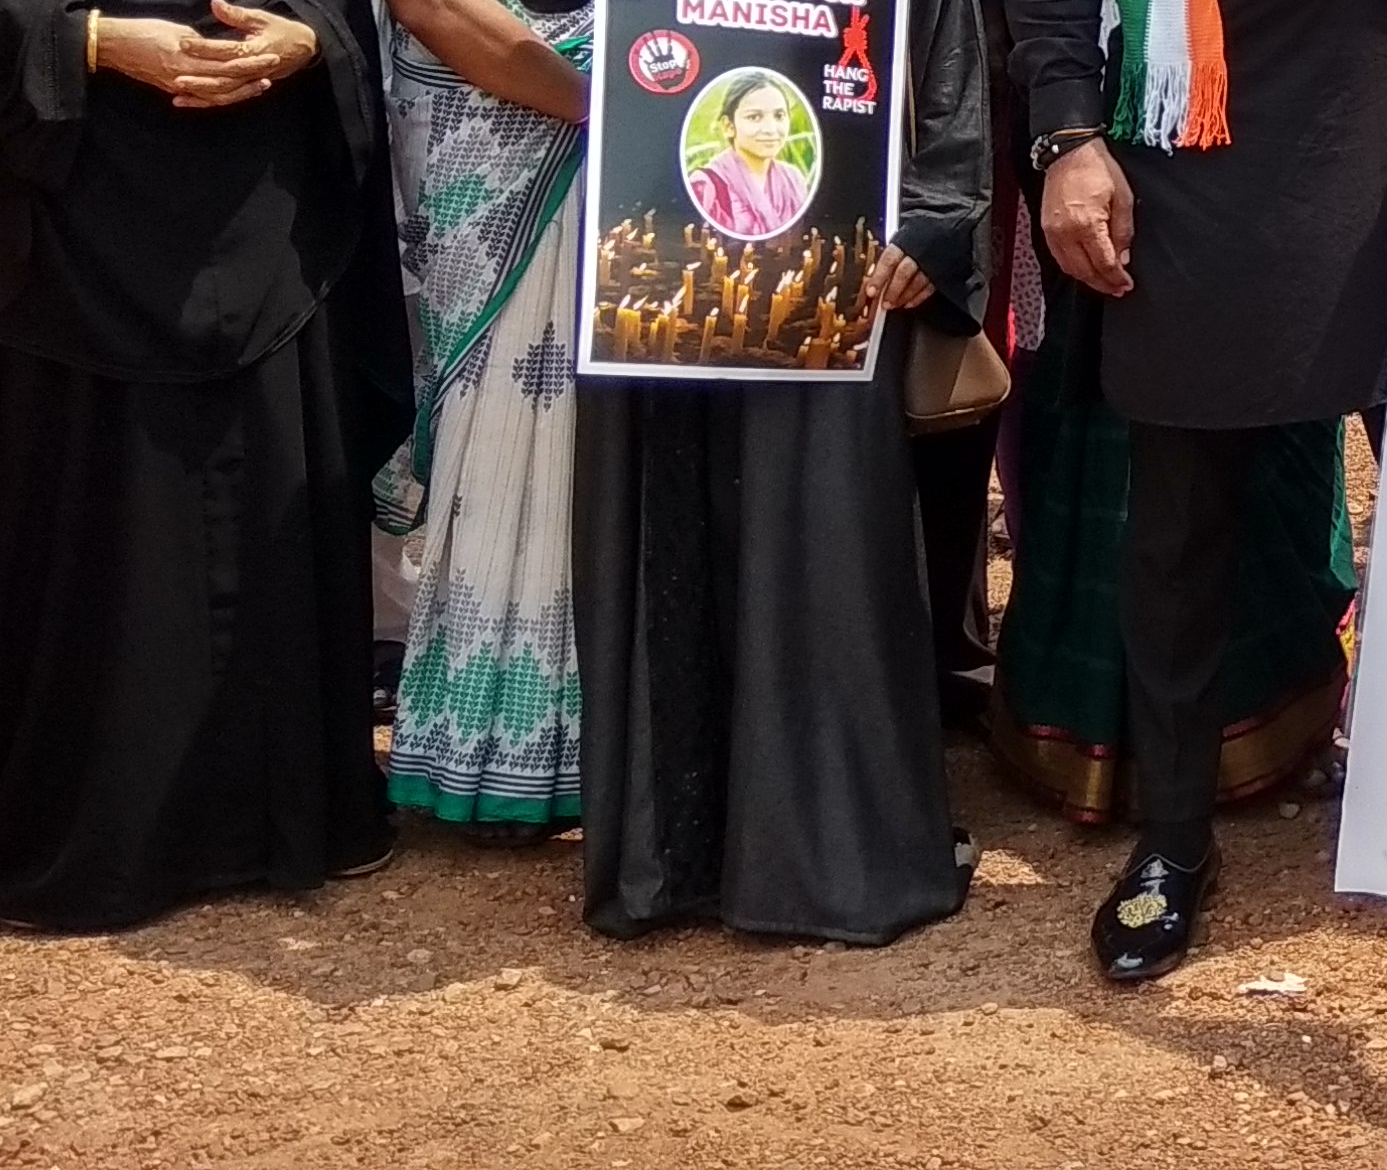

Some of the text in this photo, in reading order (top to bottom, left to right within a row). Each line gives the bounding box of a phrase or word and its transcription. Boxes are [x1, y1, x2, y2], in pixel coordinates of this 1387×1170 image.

[681, 1, 834, 35] MANISHA
[823, 64, 869, 82] HANG
[823, 80, 855, 96] THE
[822, 96, 877, 115] RAPIST
